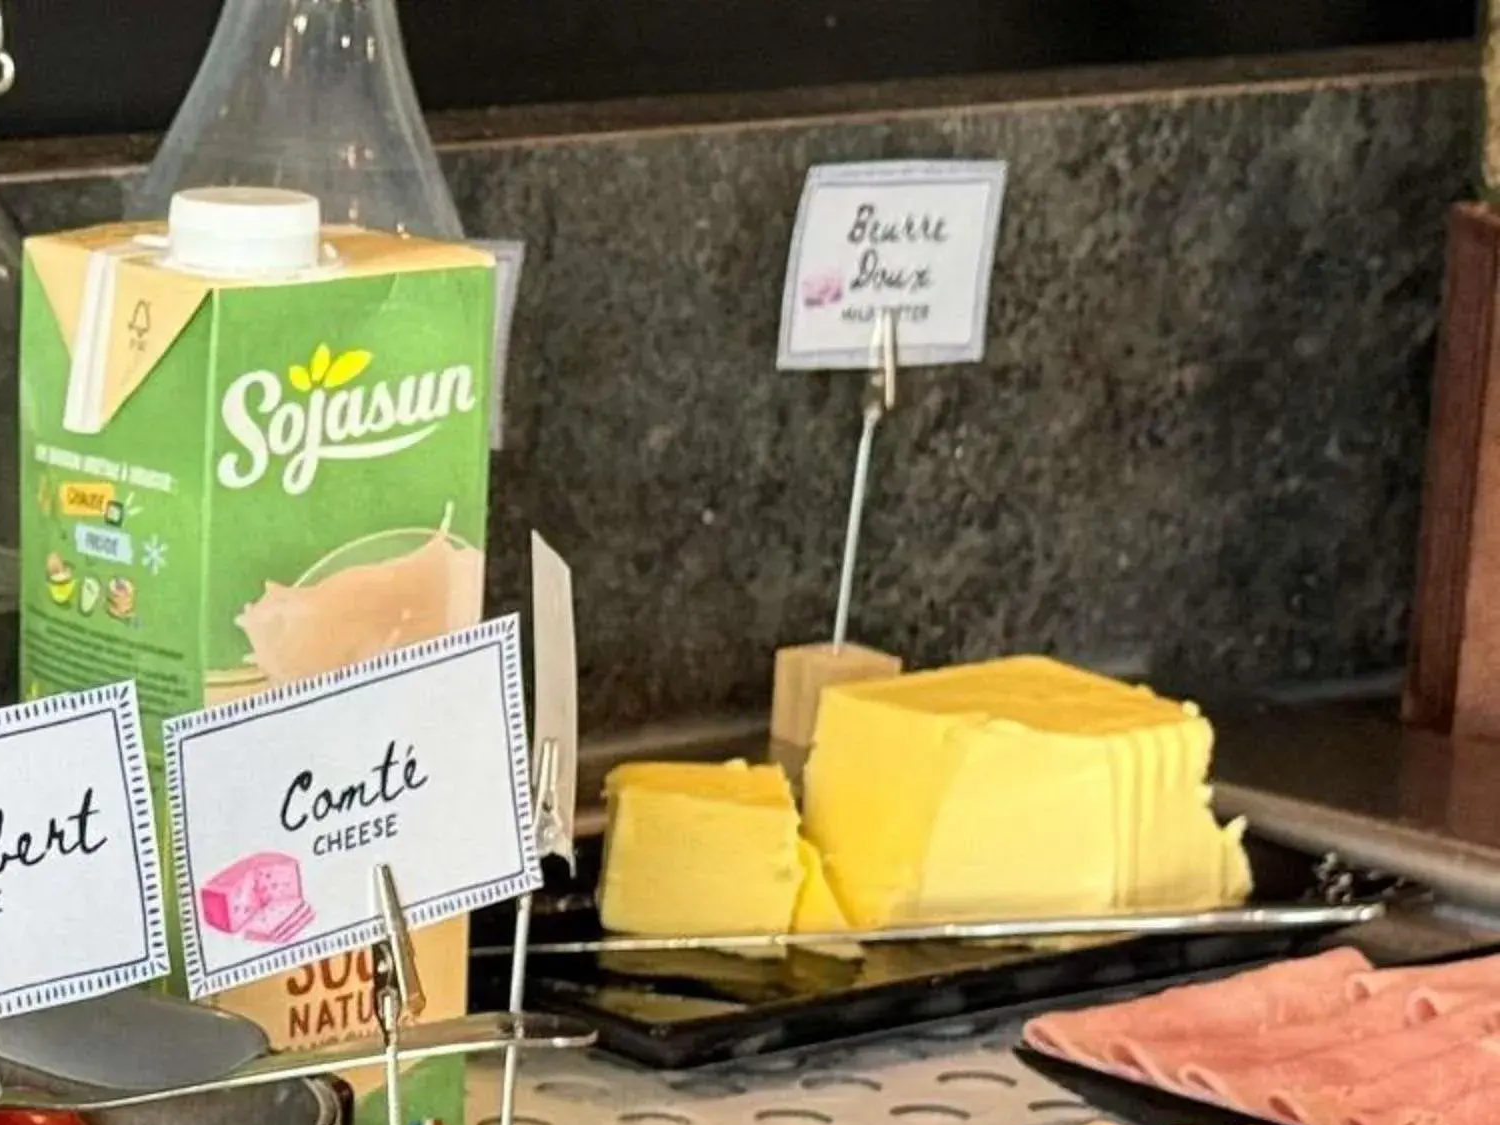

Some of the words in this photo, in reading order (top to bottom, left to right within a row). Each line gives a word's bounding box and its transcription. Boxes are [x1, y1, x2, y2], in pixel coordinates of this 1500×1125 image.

[847, 203, 948, 243] Beurre
[849, 249, 932, 290] Doux
[217, 365, 477, 495] Sojasun
[280, 740, 429, 832] Comté
[313, 813, 399, 856] CHEESE
[289, 990, 375, 1039] NATU
